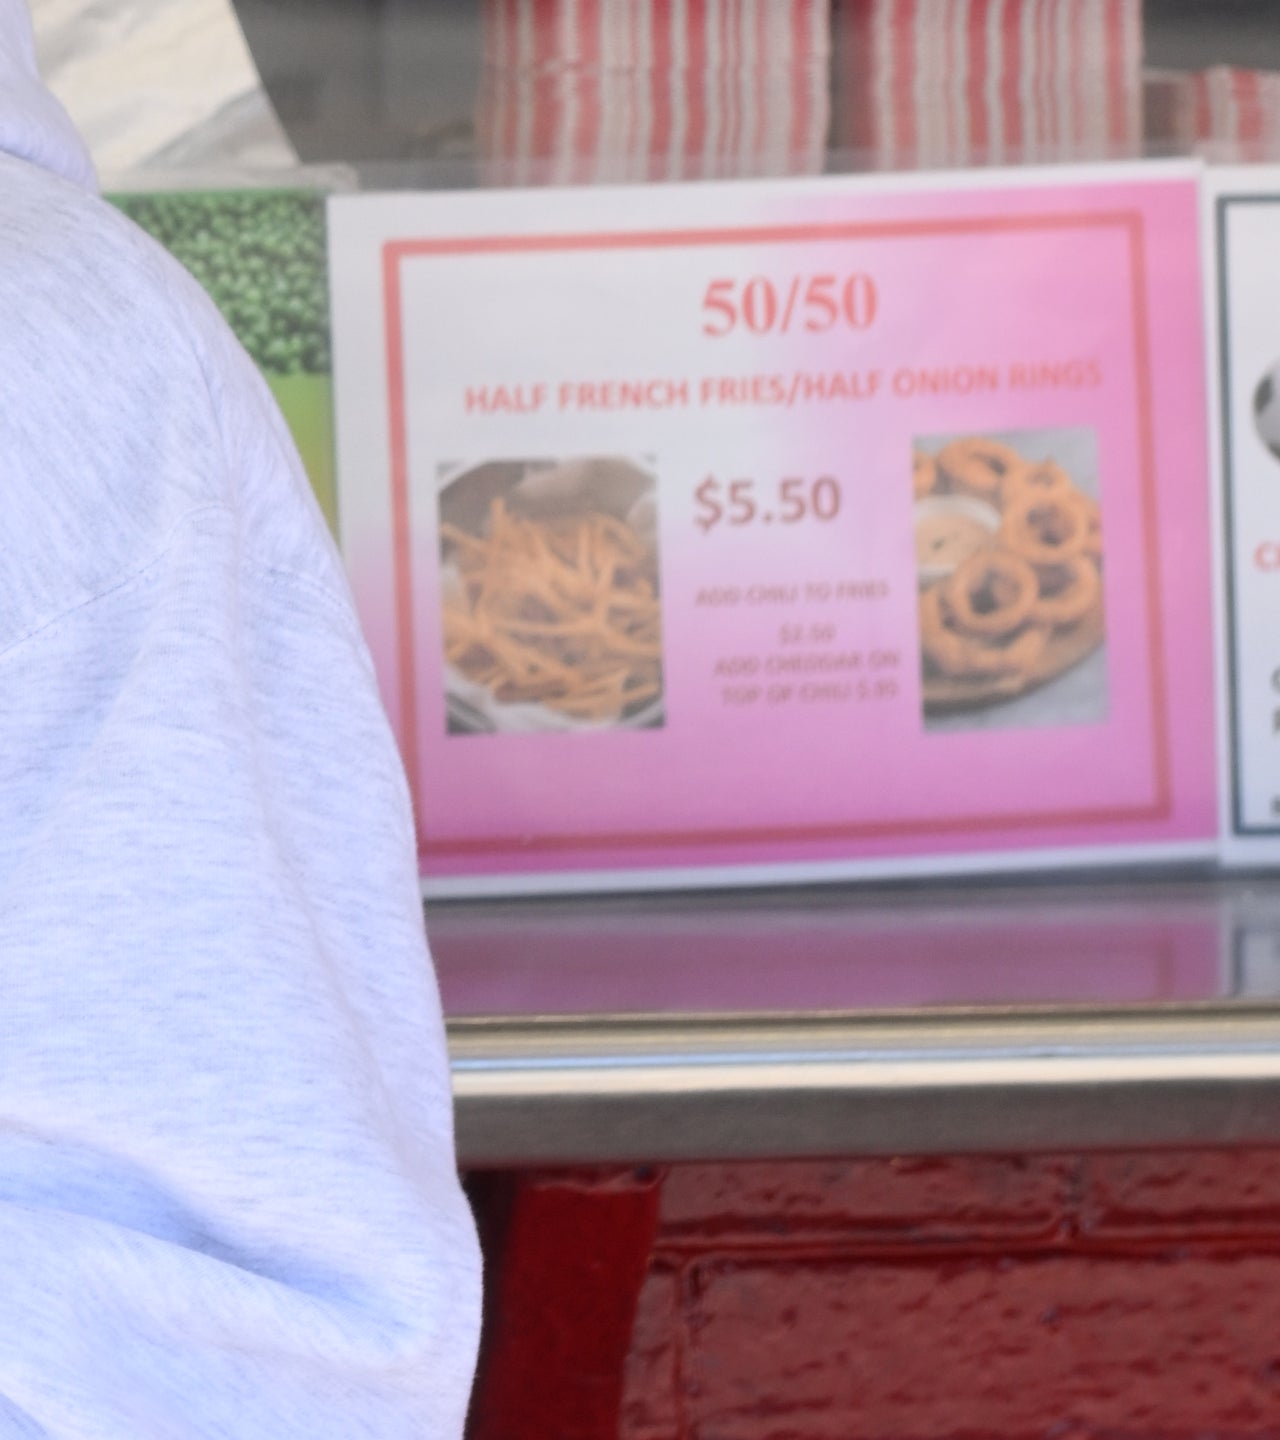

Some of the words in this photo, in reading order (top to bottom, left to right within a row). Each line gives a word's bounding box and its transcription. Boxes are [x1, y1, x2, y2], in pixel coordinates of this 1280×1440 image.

[702, 272, 879, 337] 50/50
[464, 383, 549, 416] HALF
[558, 375, 689, 413] FRENCH
[700, 366, 883, 408] FRIES/HALF
[892, 361, 1000, 400] ONION
[1008, 357, 1103, 392] RINGS
[693, 474, 843, 535] $5.50
[695, 584, 741, 607] ADD
[745, 582, 799, 606] CHILI
[805, 580, 832, 603] TO
[836, 577, 890, 601] FRIES
[714, 654, 761, 678] ADD
[765, 651, 862, 676] CHEDDAR
[867, 648, 901, 672] ON
[721, 683, 762, 708] TOP
[766, 682, 795, 706] OF
